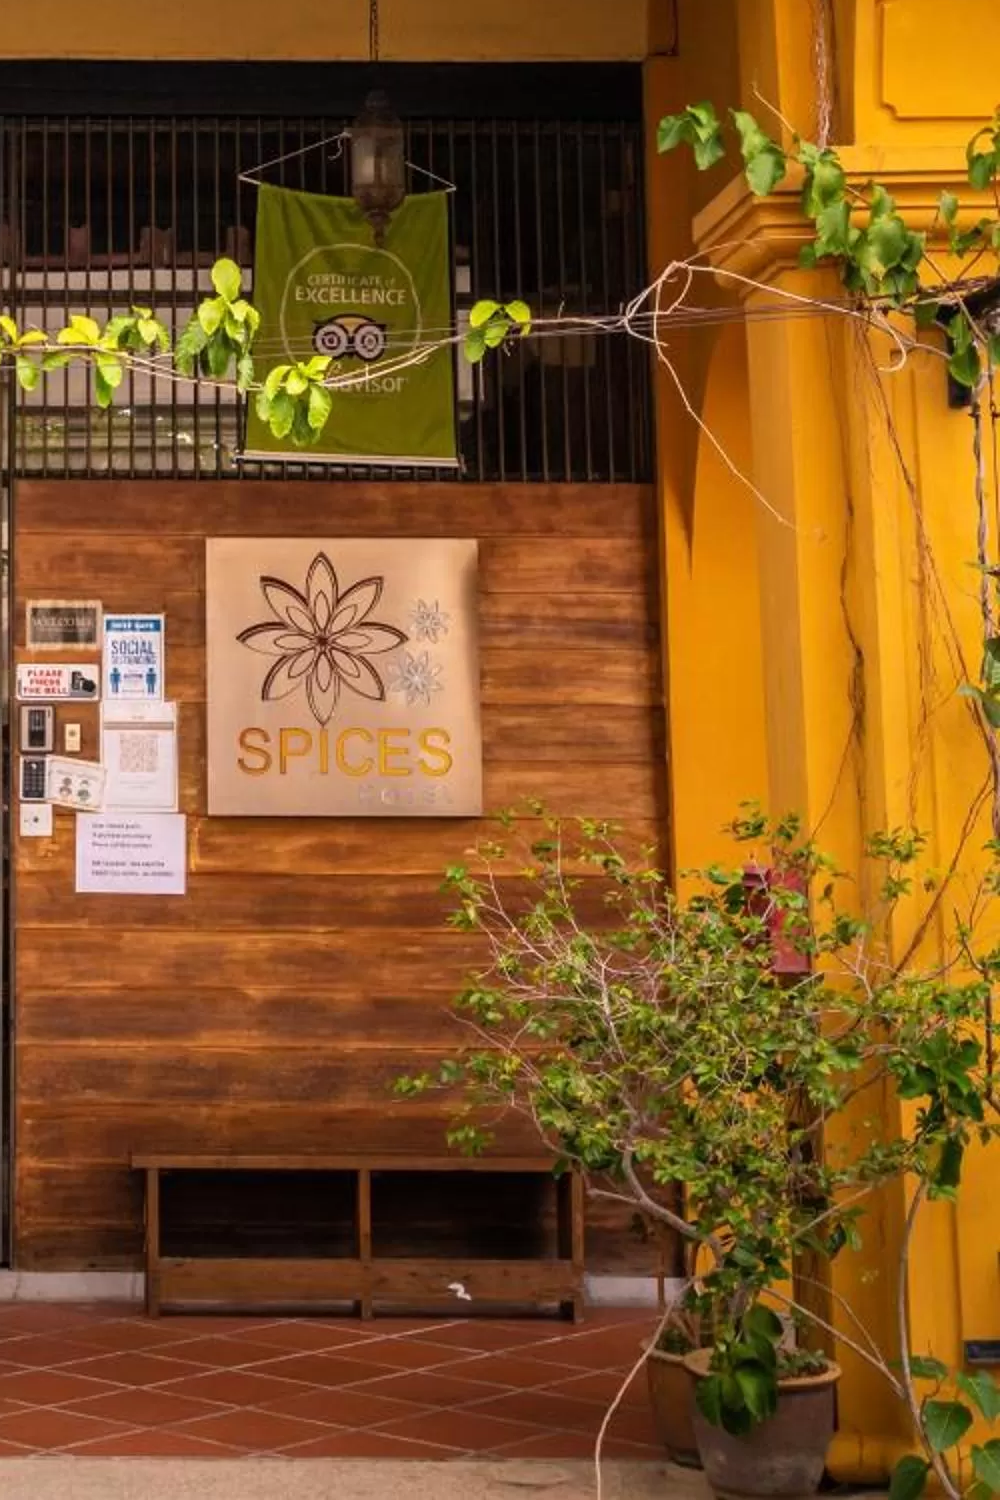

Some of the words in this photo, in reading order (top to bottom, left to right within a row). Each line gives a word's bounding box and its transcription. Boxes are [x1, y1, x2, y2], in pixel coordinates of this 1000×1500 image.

[307, 273, 380, 287] CERTIFICATE
[295, 285, 406, 306] EXCELLENCE
[111, 640, 156, 655] SOCIAL
[236, 726, 454, 777] SPICES
